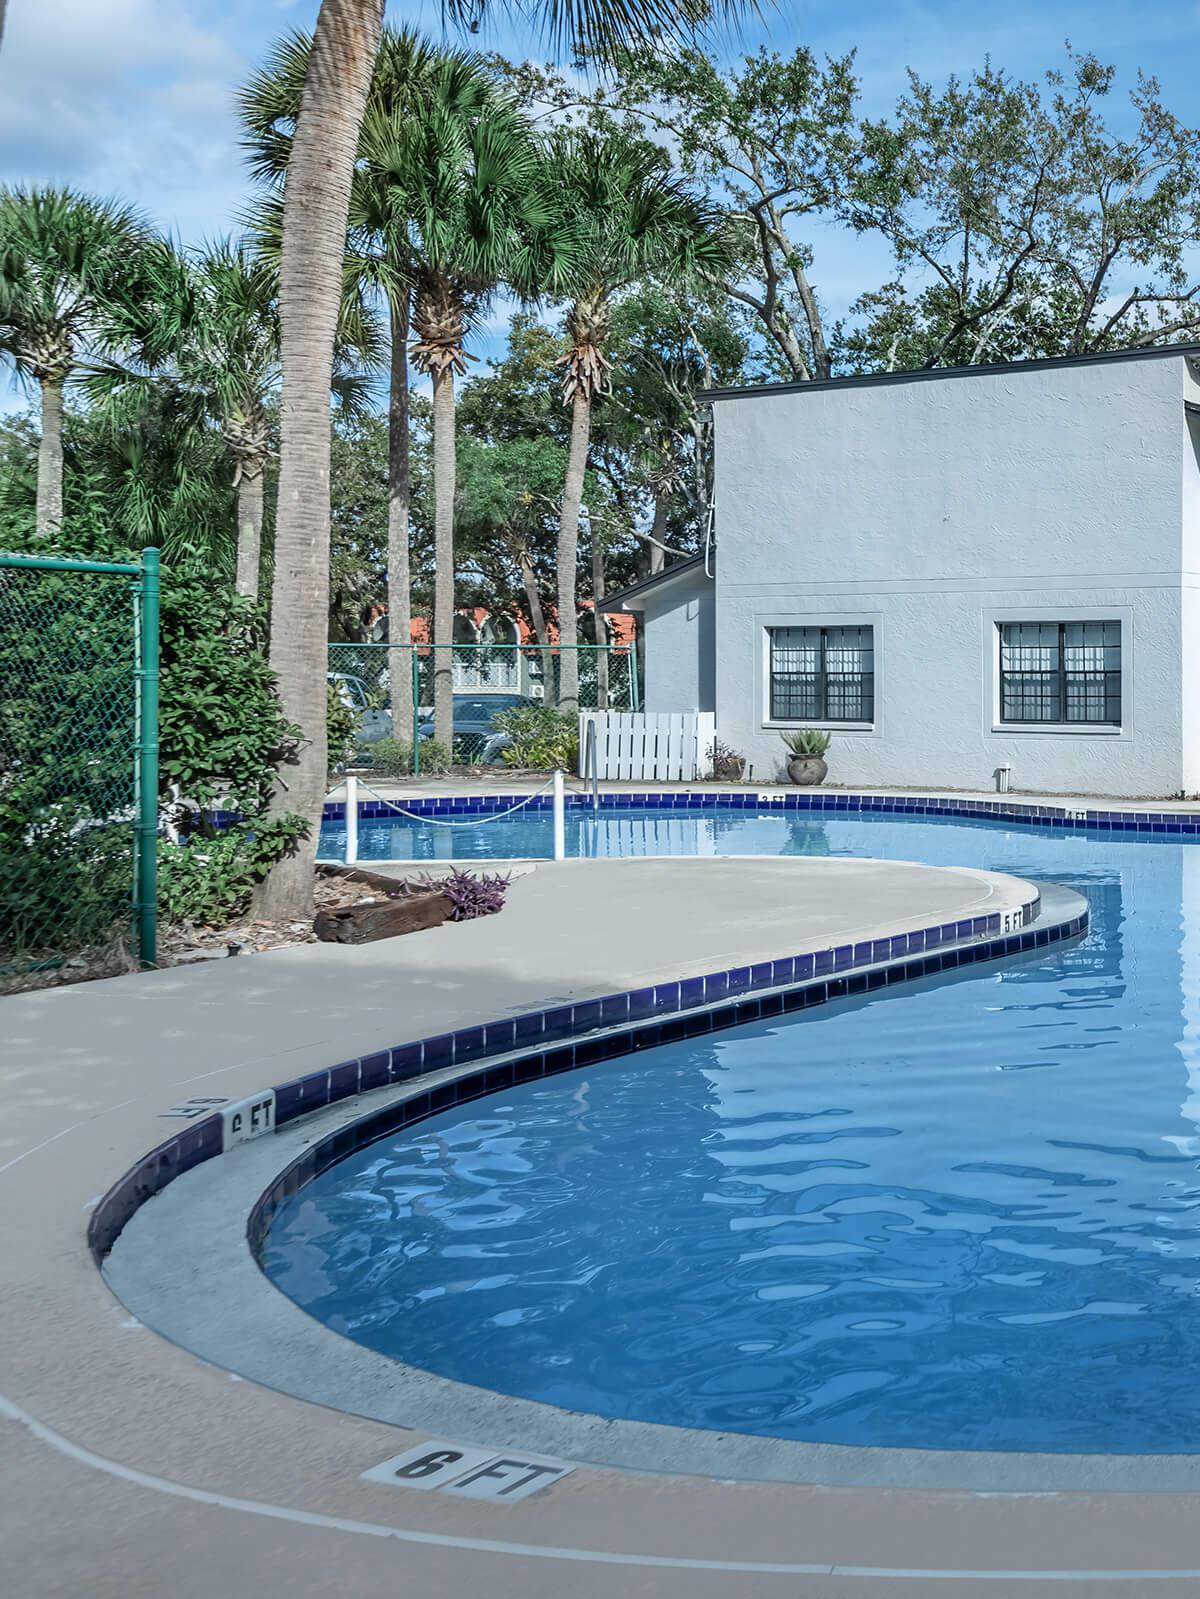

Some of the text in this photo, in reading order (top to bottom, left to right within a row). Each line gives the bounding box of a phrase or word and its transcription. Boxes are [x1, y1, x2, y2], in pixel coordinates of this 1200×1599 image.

[1004, 911, 1022, 933] 5 FT
[250, 1098, 273, 1133] FT
[394, 1450, 565, 1496] 6 FT
